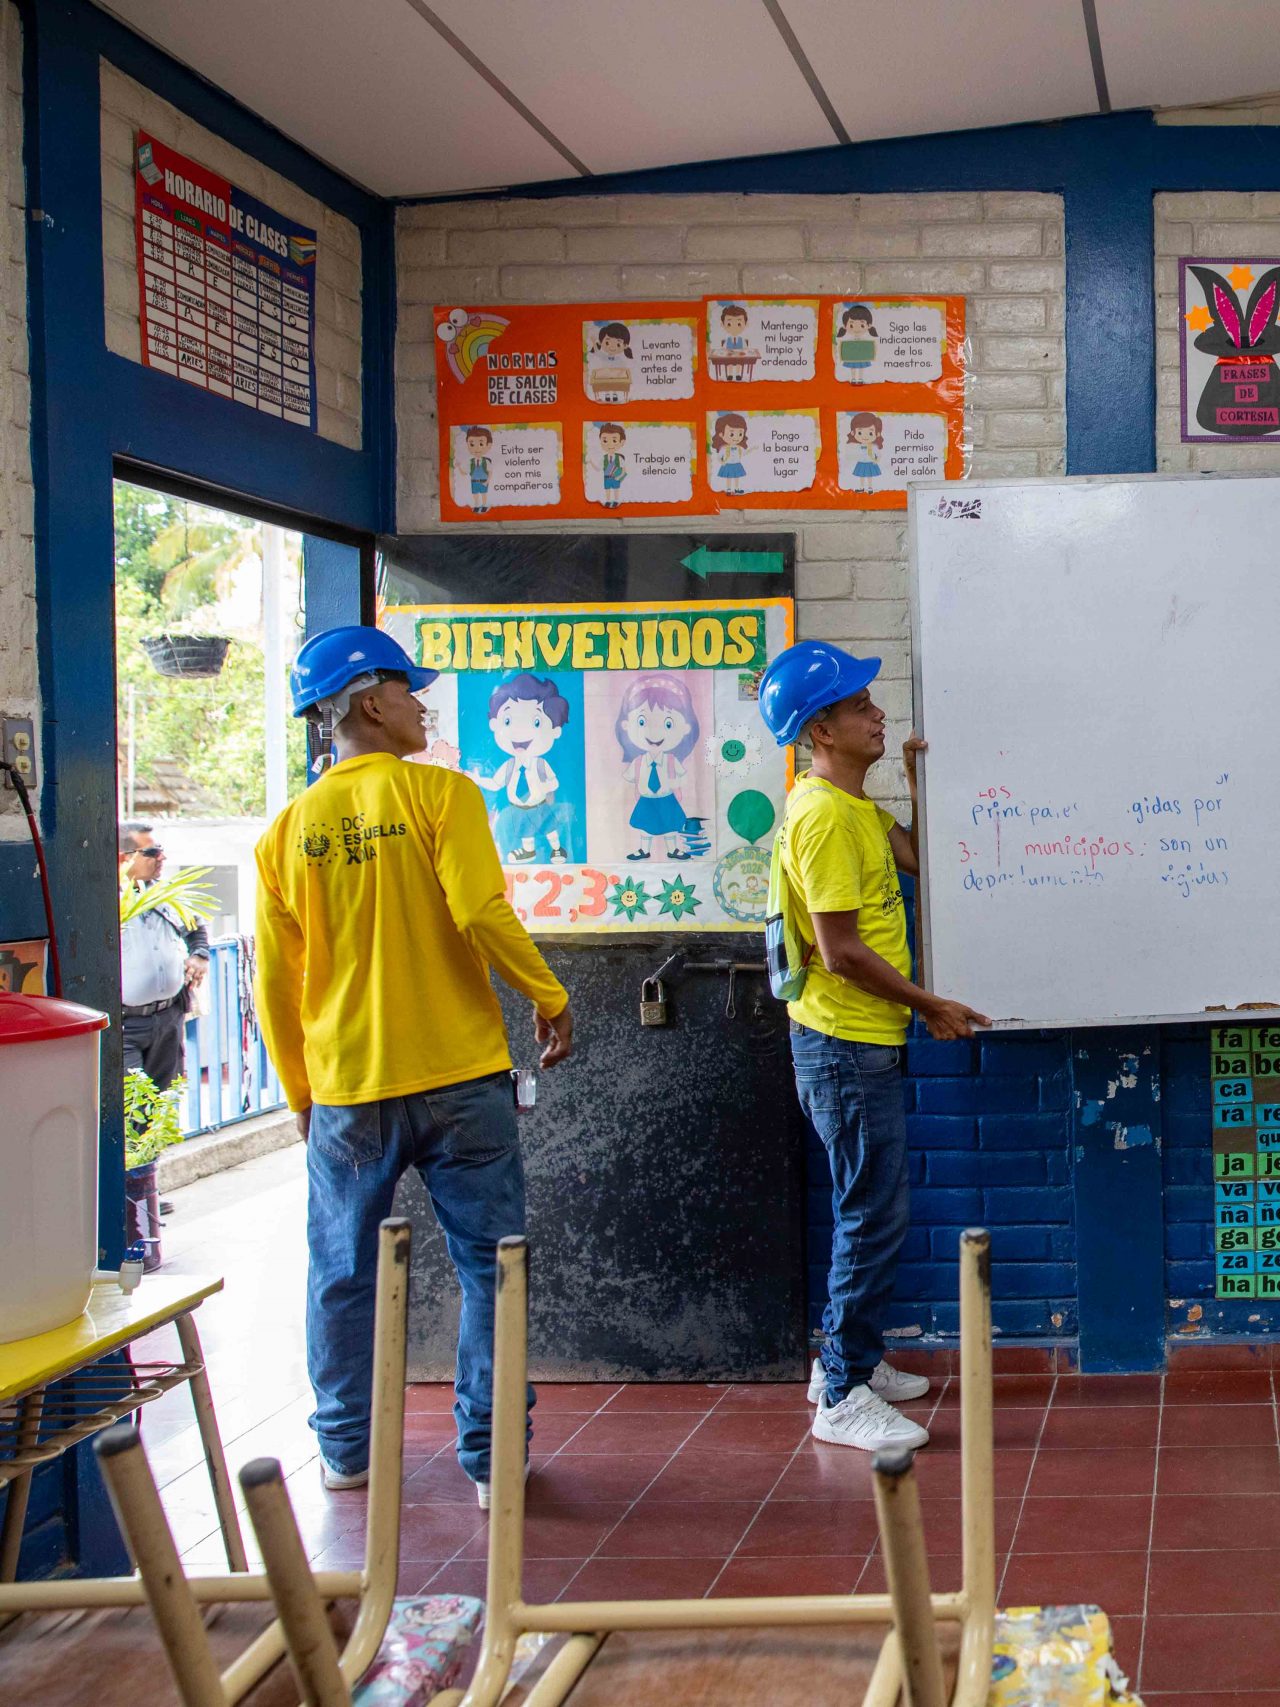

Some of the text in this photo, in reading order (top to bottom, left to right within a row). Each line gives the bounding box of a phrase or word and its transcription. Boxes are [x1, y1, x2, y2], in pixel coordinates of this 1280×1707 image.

[164, 167, 226, 223] HORARIO
[229, 204, 244, 233] DE
[246, 214, 288, 257] CLASES
[761, 321, 808, 333] Mantengo
[889, 322, 926, 334] Sigo las
[765, 333, 803, 344] mi lugar
[880, 334, 937, 344] indicaciones
[642, 340, 680, 350] Levanto
[766, 345, 803, 356] limpio y
[894, 345, 923, 355] de los
[488, 353, 558, 368] NORMAS
[641, 353, 652, 361] mi
[762, 357, 807, 367] ordenado
[641, 364, 683, 374] antes de
[1224, 370, 1266, 379] FRASES
[489, 376, 556, 390] DEL SALON
[646, 375, 677, 385] hablar
[489, 390, 556, 404] DE CLASES
[1240, 389, 1254, 399] DE
[1220, 411, 1274, 422] CORTESIA
[771, 431, 799, 443] Pongo
[904, 431, 925, 440] Pido
[501, 445, 523, 454] Evito
[762, 443, 808, 452] la basura
[895, 443, 934, 454] permiso
[505, 457, 540, 466] violento
[634, 454, 669, 466] Trabajo
[891, 454, 938, 466] para salir
[525, 469, 541, 478] mis
[642, 466, 677, 475] silencio
[774, 466, 799, 478] lugar
[894, 465, 936, 475] del salón
[494, 480, 553, 492] compañeros
[420, 616, 758, 670] BIENVENIDOS
[1217, 1028, 1242, 1048] fa
[1215, 1056, 1247, 1074] ba
[1220, 1082, 1246, 1097] ca
[1222, 1107, 1244, 1122] ra
[1222, 1154, 1244, 1175] ja
[1221, 1182, 1247, 1197] va
[1221, 1206, 1249, 1224] ña
[1221, 1231, 1248, 1249] ga
[1223, 1255, 1248, 1269] za
[1222, 1277, 1250, 1293] ha
